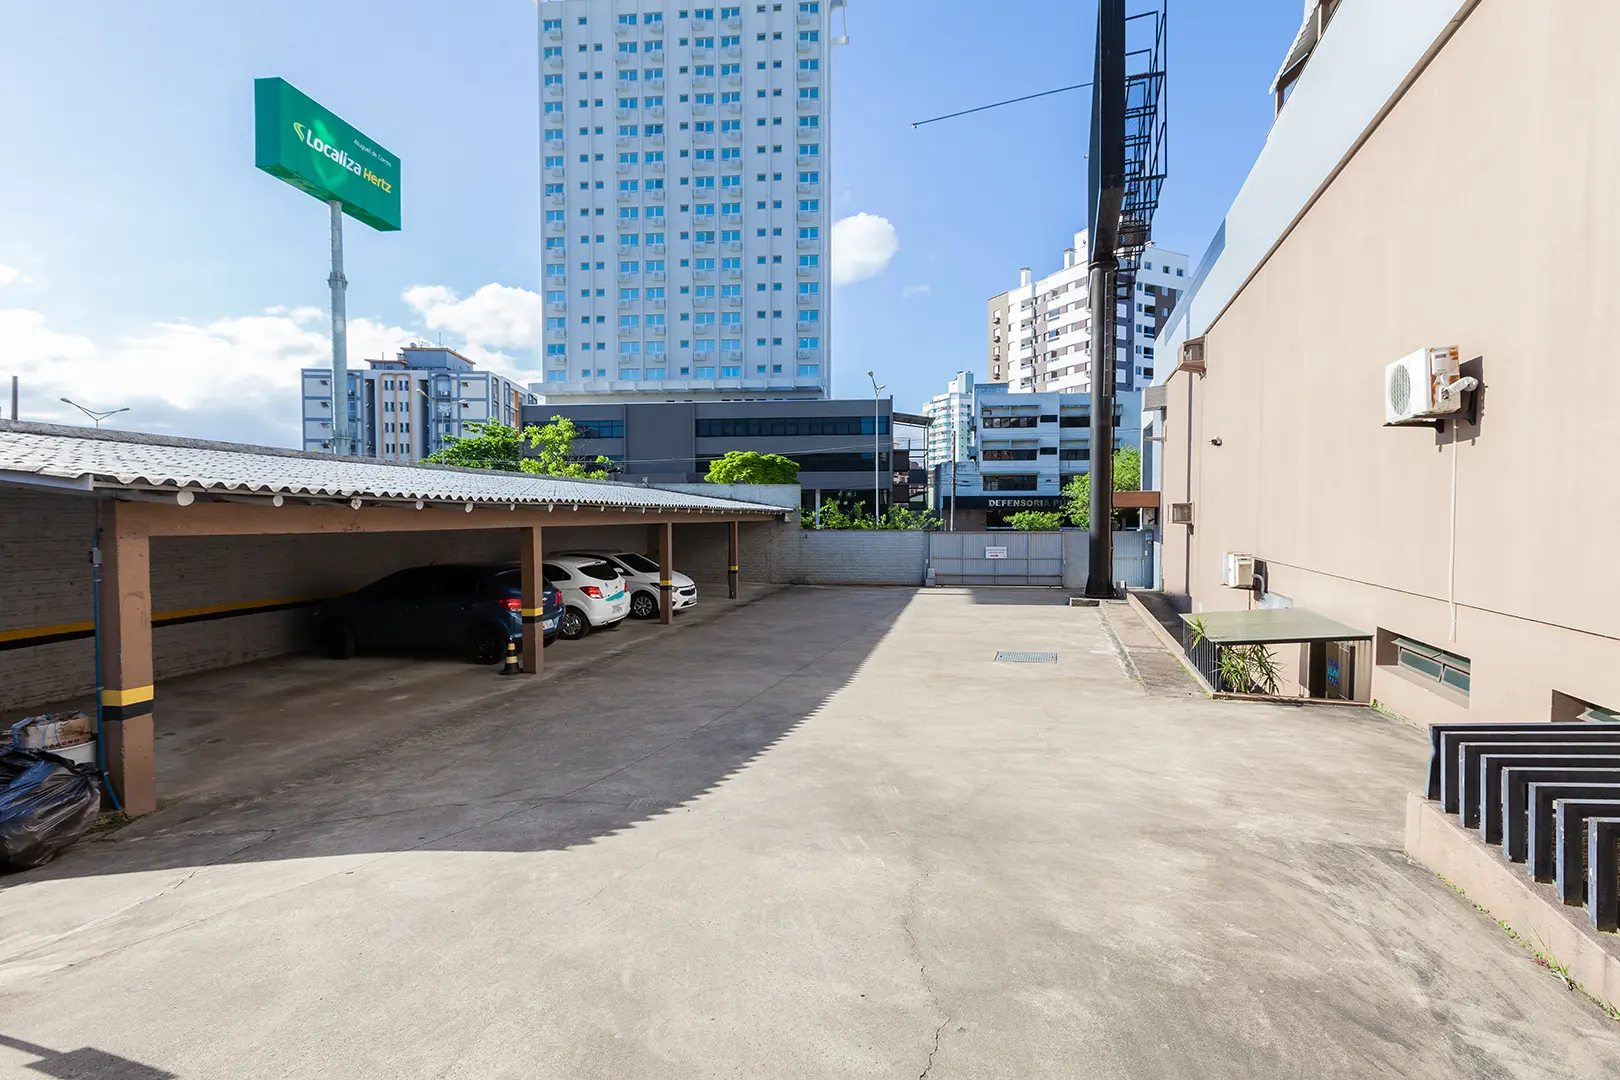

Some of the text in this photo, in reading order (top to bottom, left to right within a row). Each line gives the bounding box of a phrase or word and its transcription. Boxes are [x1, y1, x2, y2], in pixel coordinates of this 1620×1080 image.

[306, 129, 392, 193] Localiza Hertz
[988, 499, 1051, 507] DEFENSORIA
